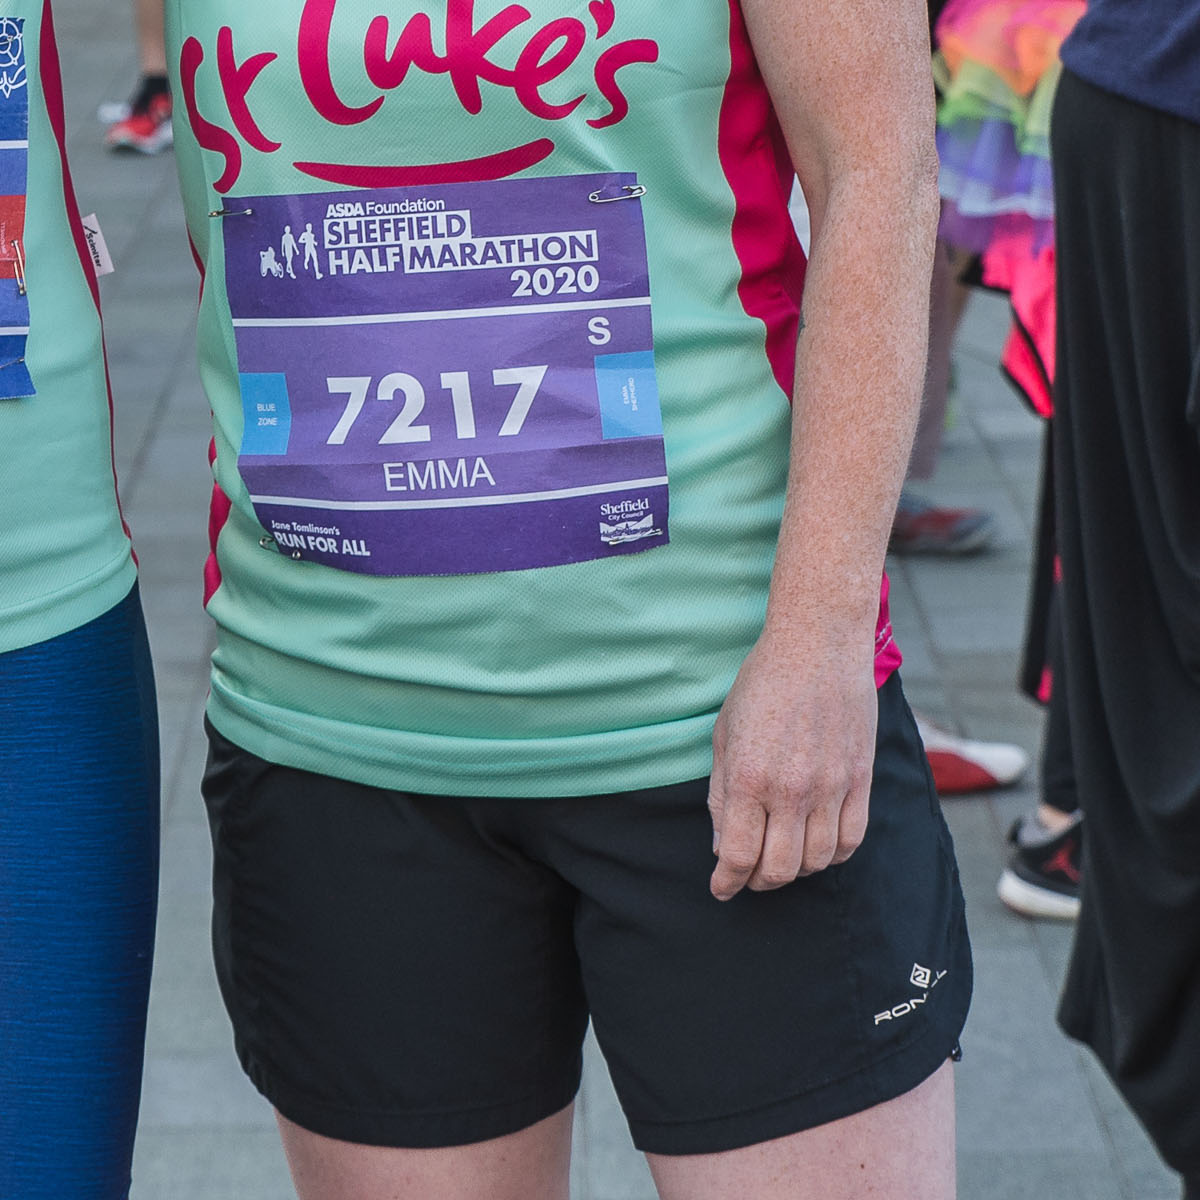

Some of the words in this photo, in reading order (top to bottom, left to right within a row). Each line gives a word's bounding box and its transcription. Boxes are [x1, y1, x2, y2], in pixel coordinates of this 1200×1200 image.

[180, 26, 282, 194] St
[326, 202, 365, 218] ASDA
[366, 198, 445, 215] Foundation
[326, 213, 467, 246] SHEFFIELD
[328, 244, 400, 276] HALF
[408, 233, 594, 271] MARATHON
[510, 264, 600, 297] 2020
[587, 316, 612, 346] S
[256, 403, 276, 412] BLUE
[326, 364, 549, 445] 7217
[257, 417, 278, 426] ZONE
[382, 456, 496, 492] EMMA
[600, 497, 650, 516] Sheffield
[271, 519, 291, 531] Jane
[291, 521, 341, 536] Tomlinson's
[273, 531, 307, 550] RUN
[307, 534, 339, 554] FOR
[342, 539, 371, 557] ALL
